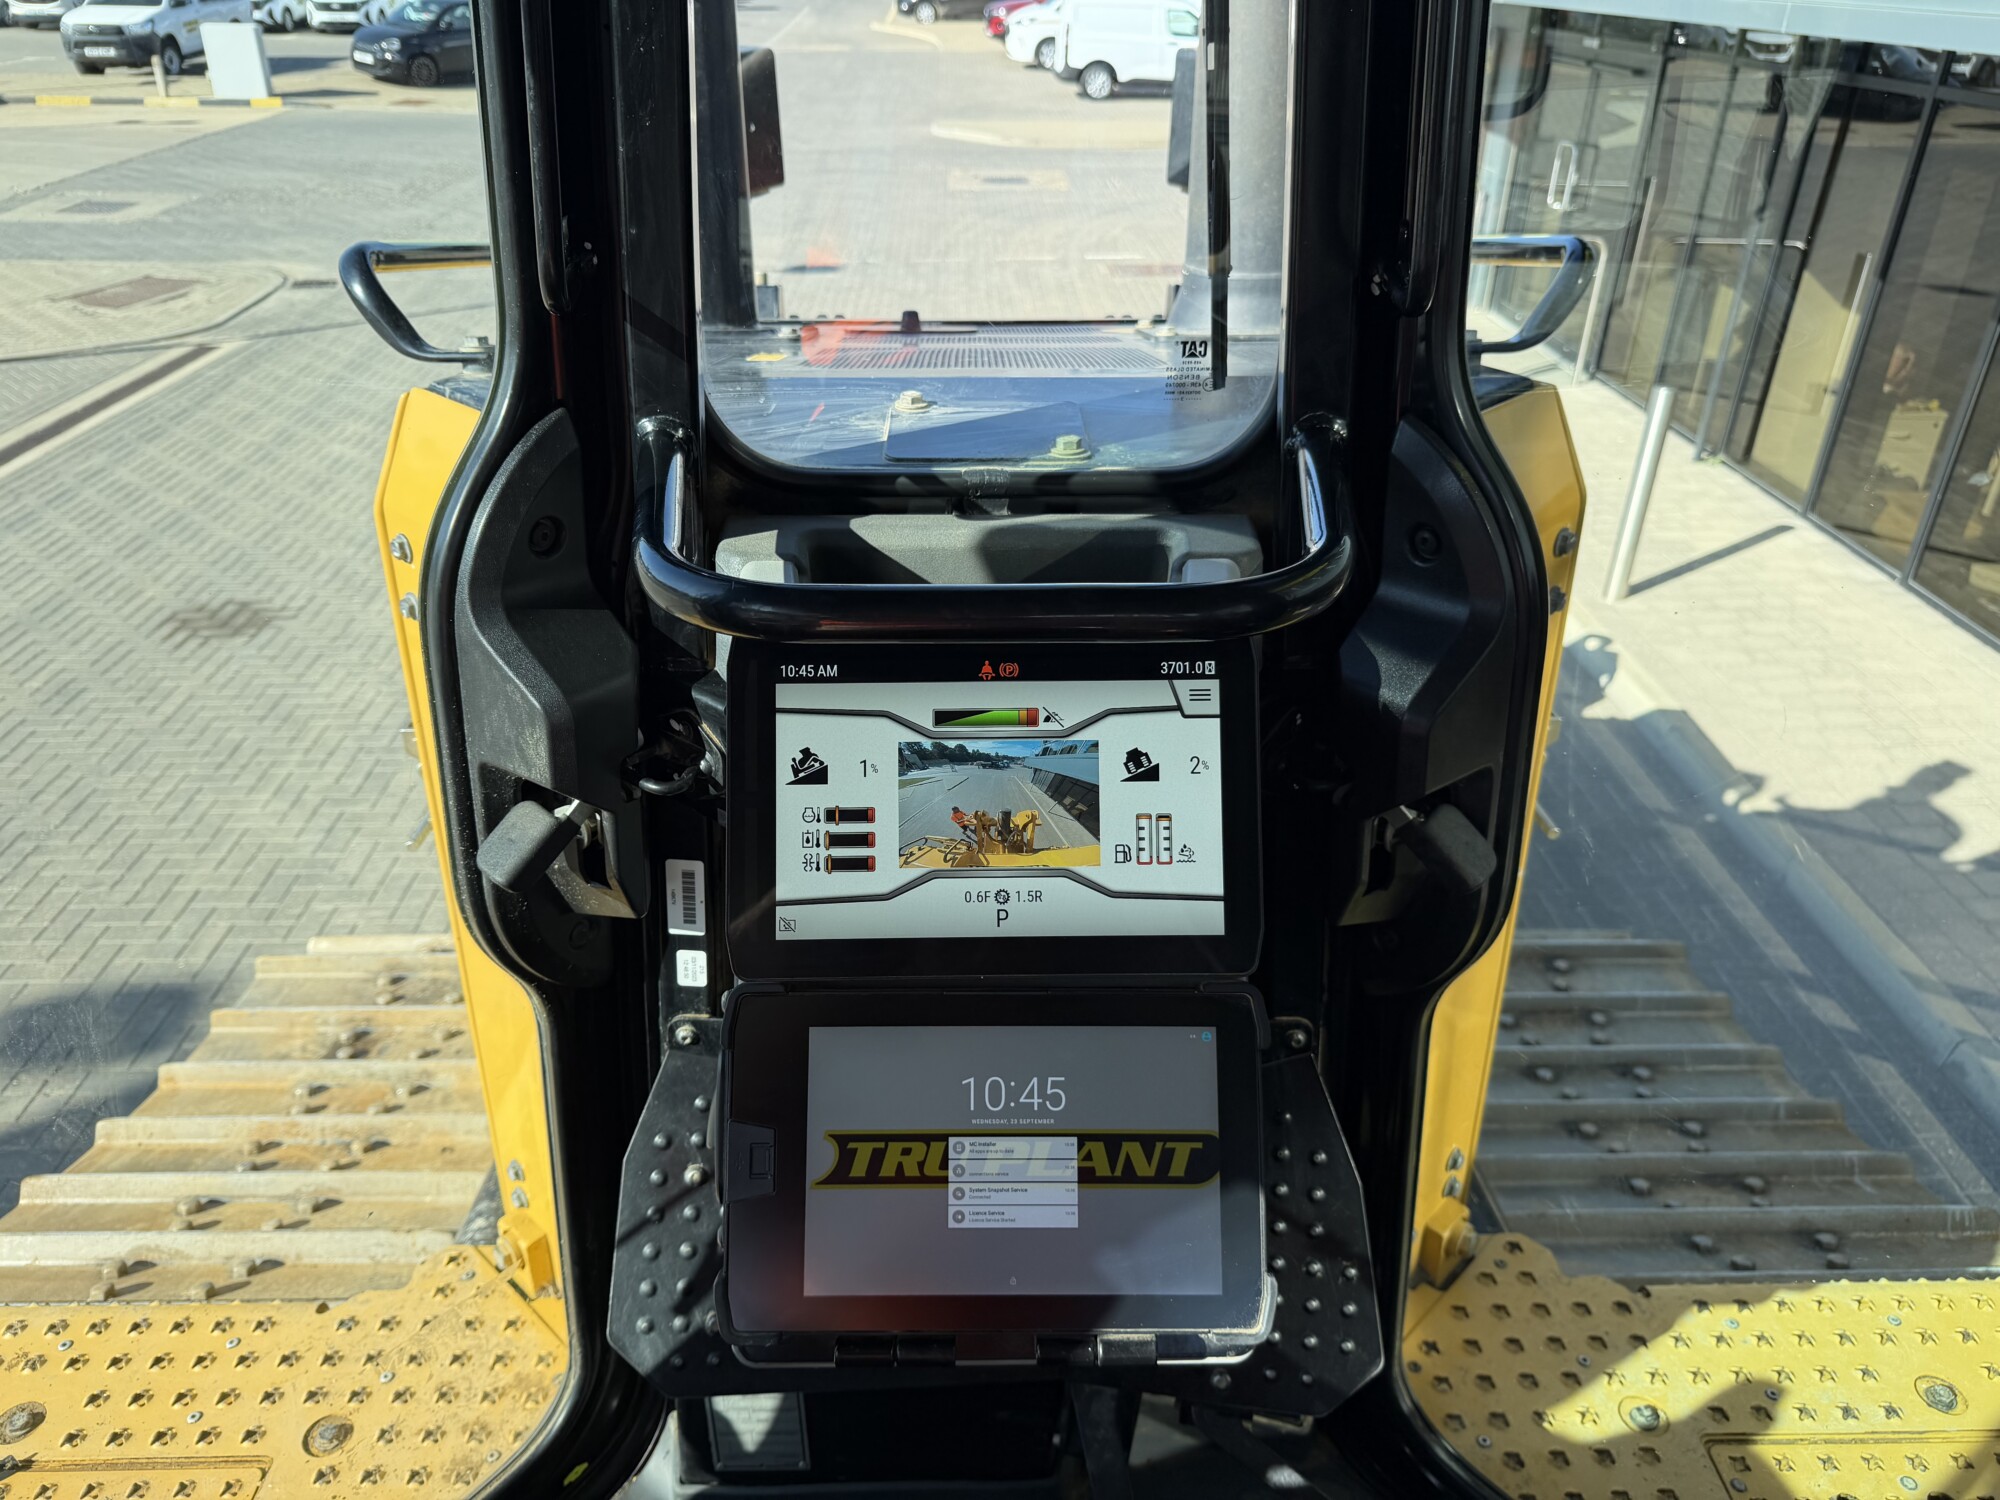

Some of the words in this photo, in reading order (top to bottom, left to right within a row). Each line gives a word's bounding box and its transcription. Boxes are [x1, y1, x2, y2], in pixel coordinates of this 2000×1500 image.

[780, 664, 815, 678] 10:45
[817, 664, 838, 678] AM
[1160, 661, 1203, 674] 3701.0
[964, 890, 991, 903] 0.6F
[1015, 890, 1042, 903] 1.5R
[997, 908, 1009, 927] P
[962, 1076, 1066, 1111] 10:45
